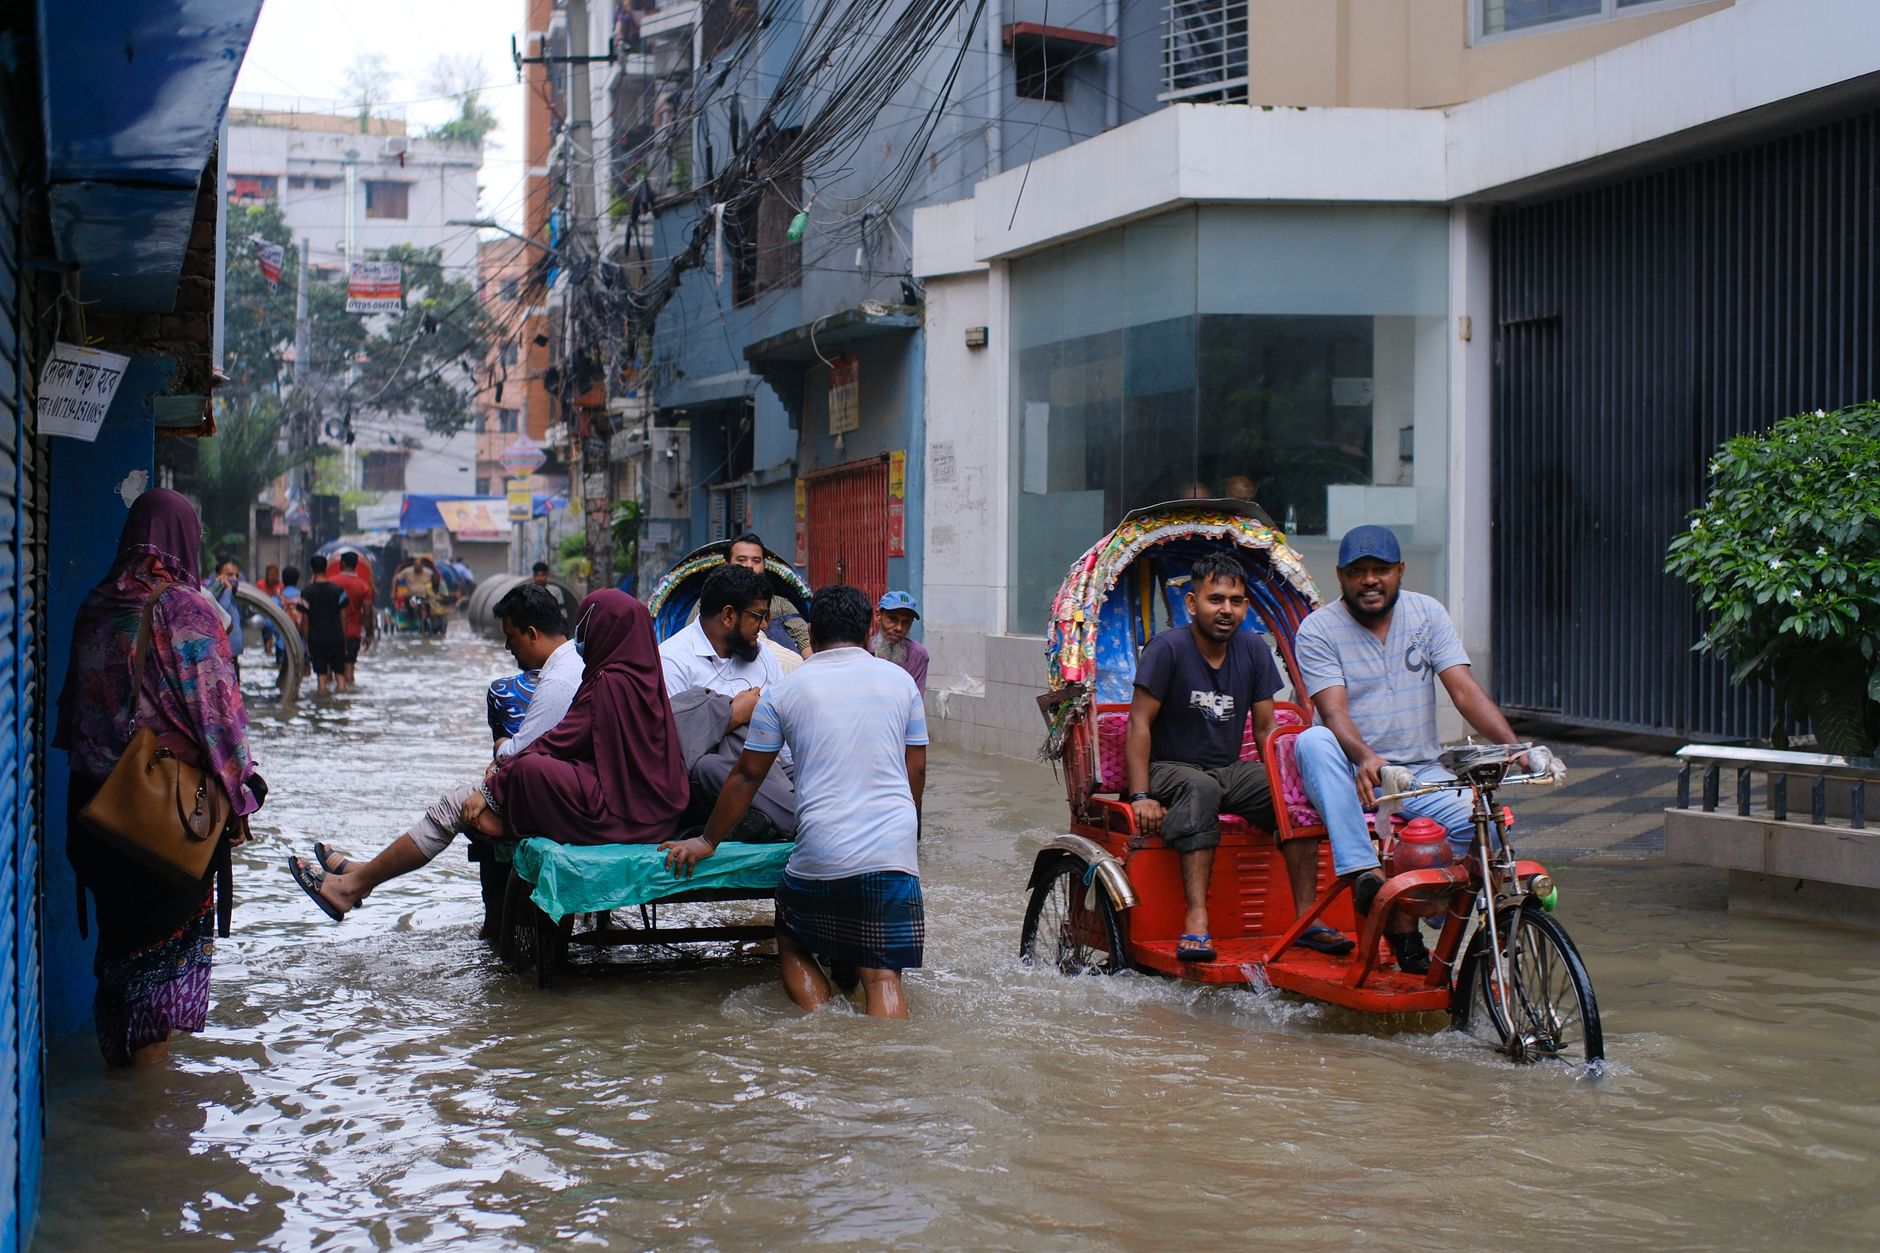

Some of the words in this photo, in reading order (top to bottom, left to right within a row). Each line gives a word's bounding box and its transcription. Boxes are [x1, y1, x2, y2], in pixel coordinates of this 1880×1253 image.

[43, 358, 78, 388] দোকান
[75, 362, 101, 395] ভাড়া
[97, 367, 121, 396] হবে
